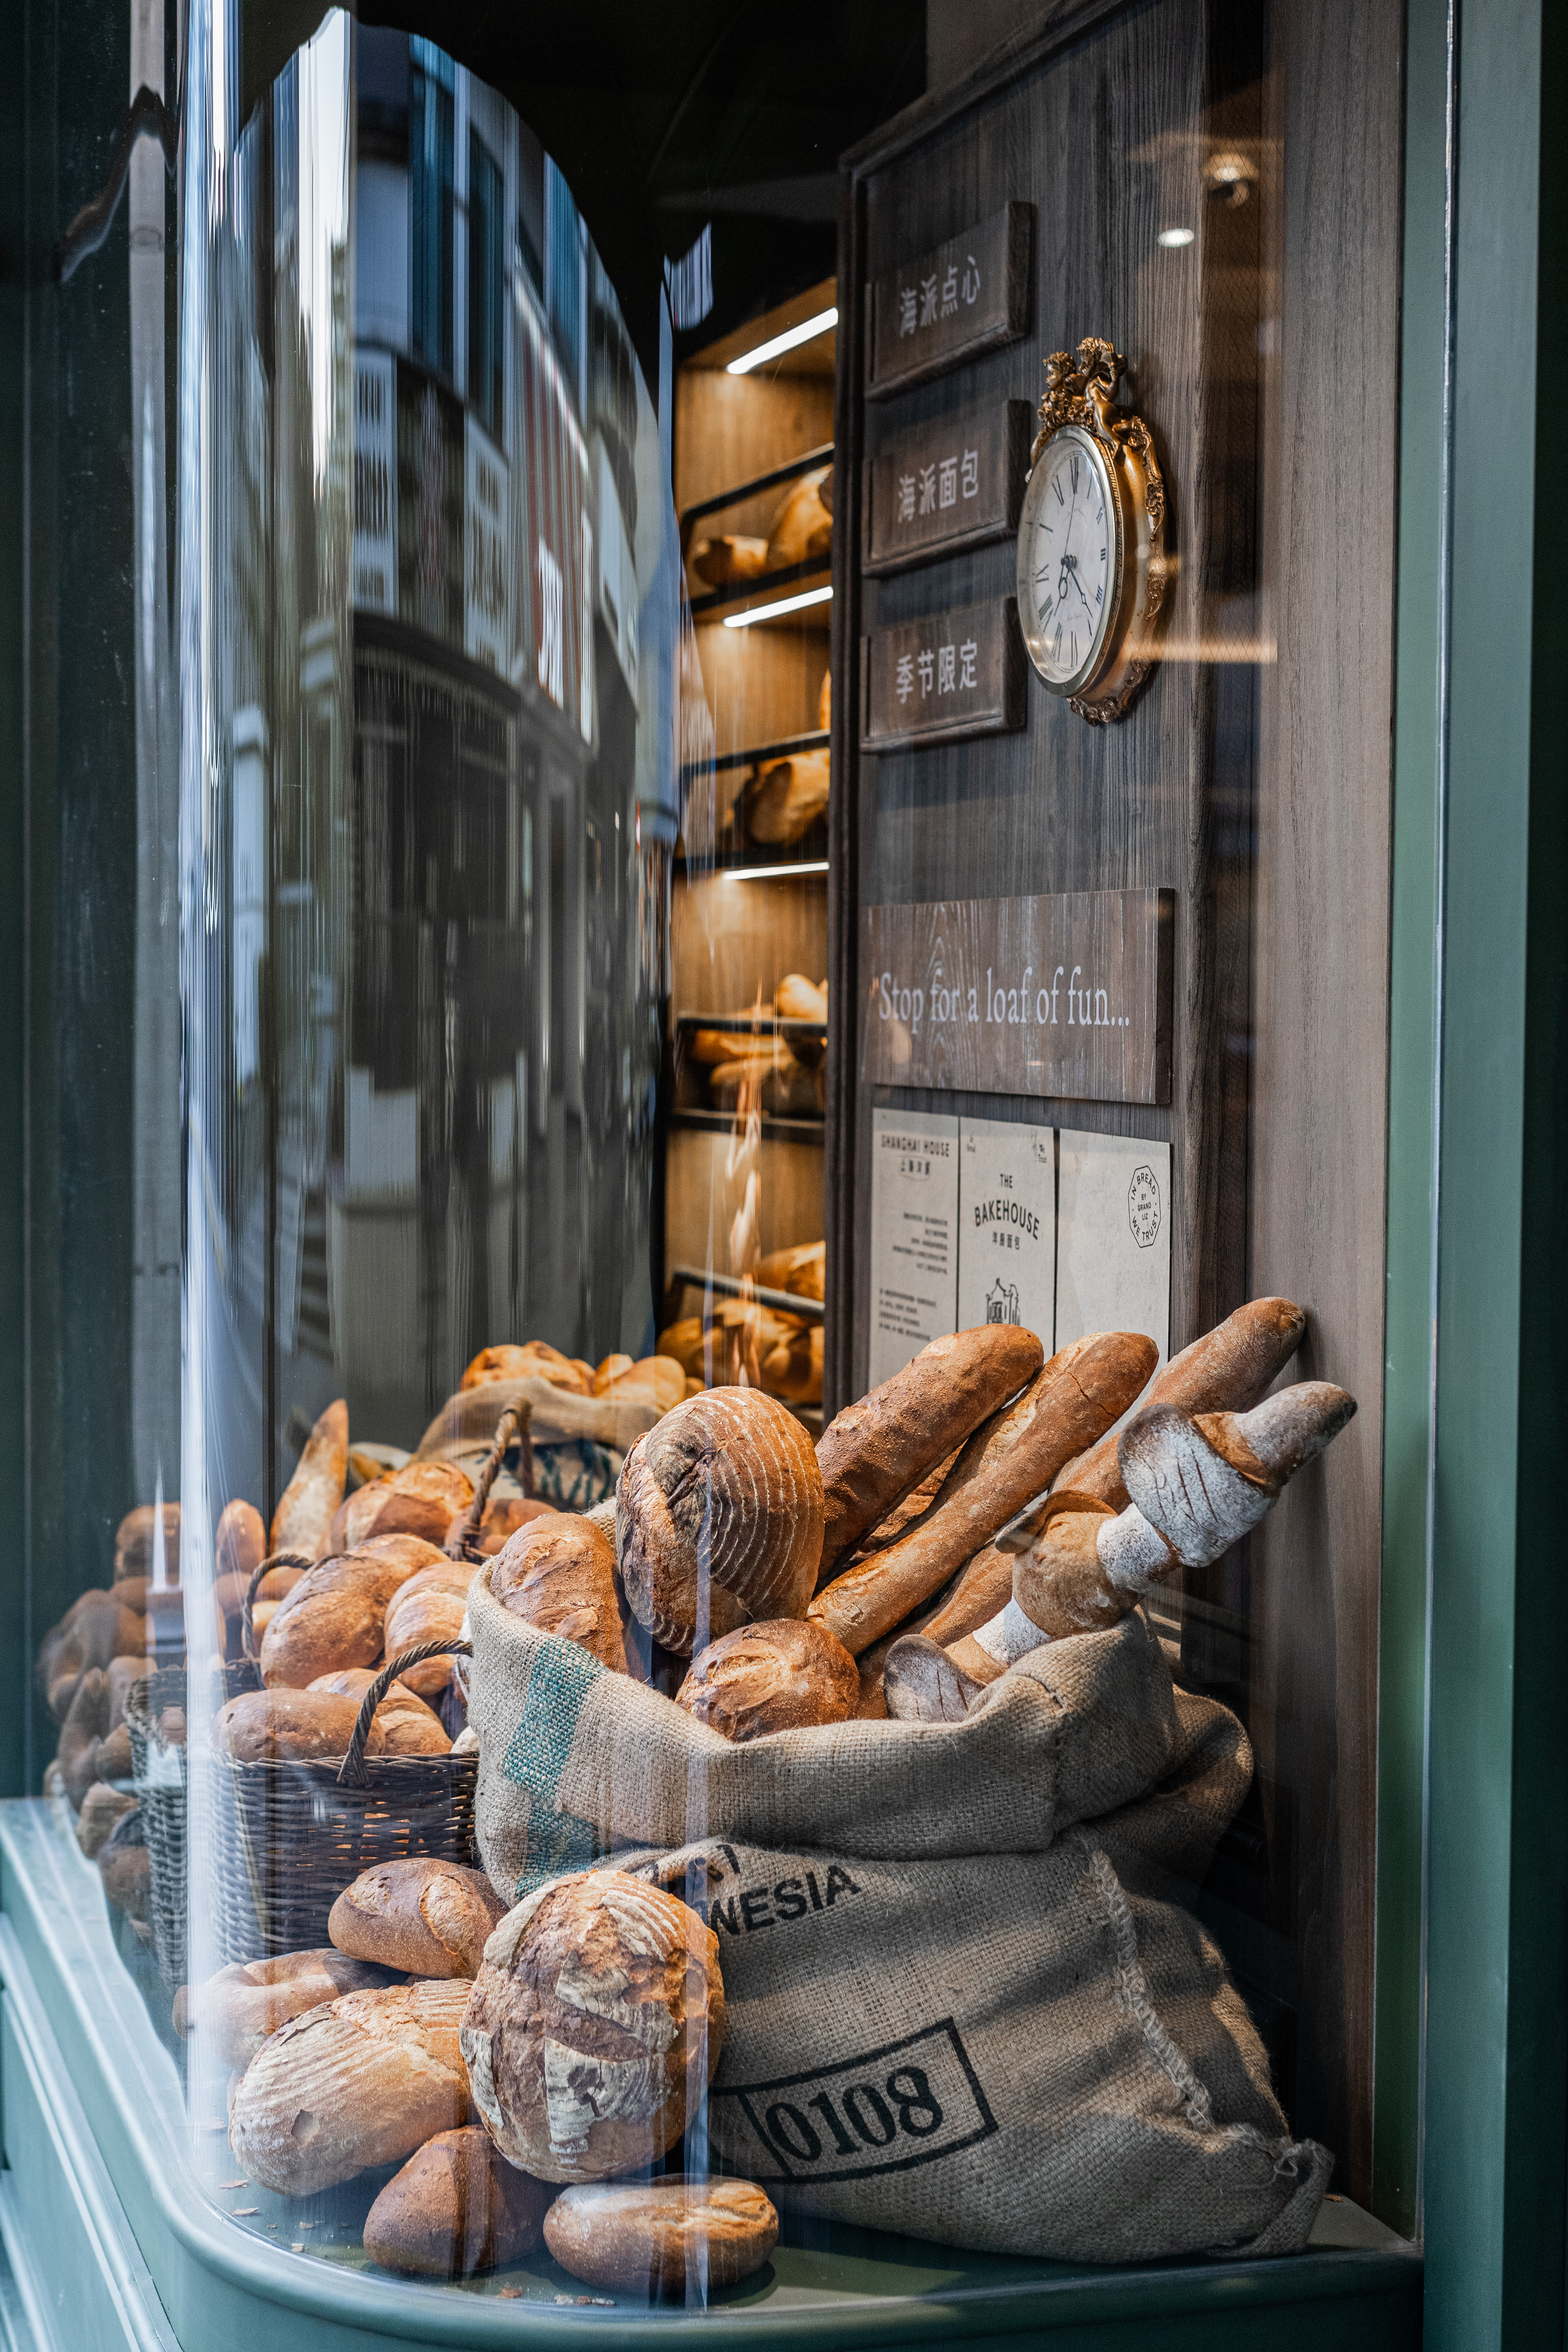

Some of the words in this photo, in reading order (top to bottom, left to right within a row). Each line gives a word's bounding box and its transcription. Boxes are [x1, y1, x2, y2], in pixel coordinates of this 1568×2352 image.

[900, 255, 980, 338] 海派点心
[898, 449, 978, 523] 海派面包
[897, 638, 978, 704] 季节限定
[878, 972, 924, 1034] Stop
[931, 968, 960, 1022] for
[967, 988, 979, 1023] a
[986, 966, 1033, 1024] loaf
[1036, 966, 1064, 1025] of
[1068, 965, 1129, 1026] fun...
[882, 1134, 920, 1152] SHANGHAI
[924, 1139, 949, 1157] HOUSE
[1000, 1174, 1013, 1189] THE
[1131, 1185, 1137, 1200] IN
[1137, 1172, 1156, 1195] BREAD
[974, 1200, 1040, 1241] BAKEHOUSE
[1132, 1216, 1140, 1236] WE
[1142, 1210, 1158, 1241] TRUST
[1138, 1202, 1151, 1212] GRAND
[765, 2065, 942, 2161] 0108
